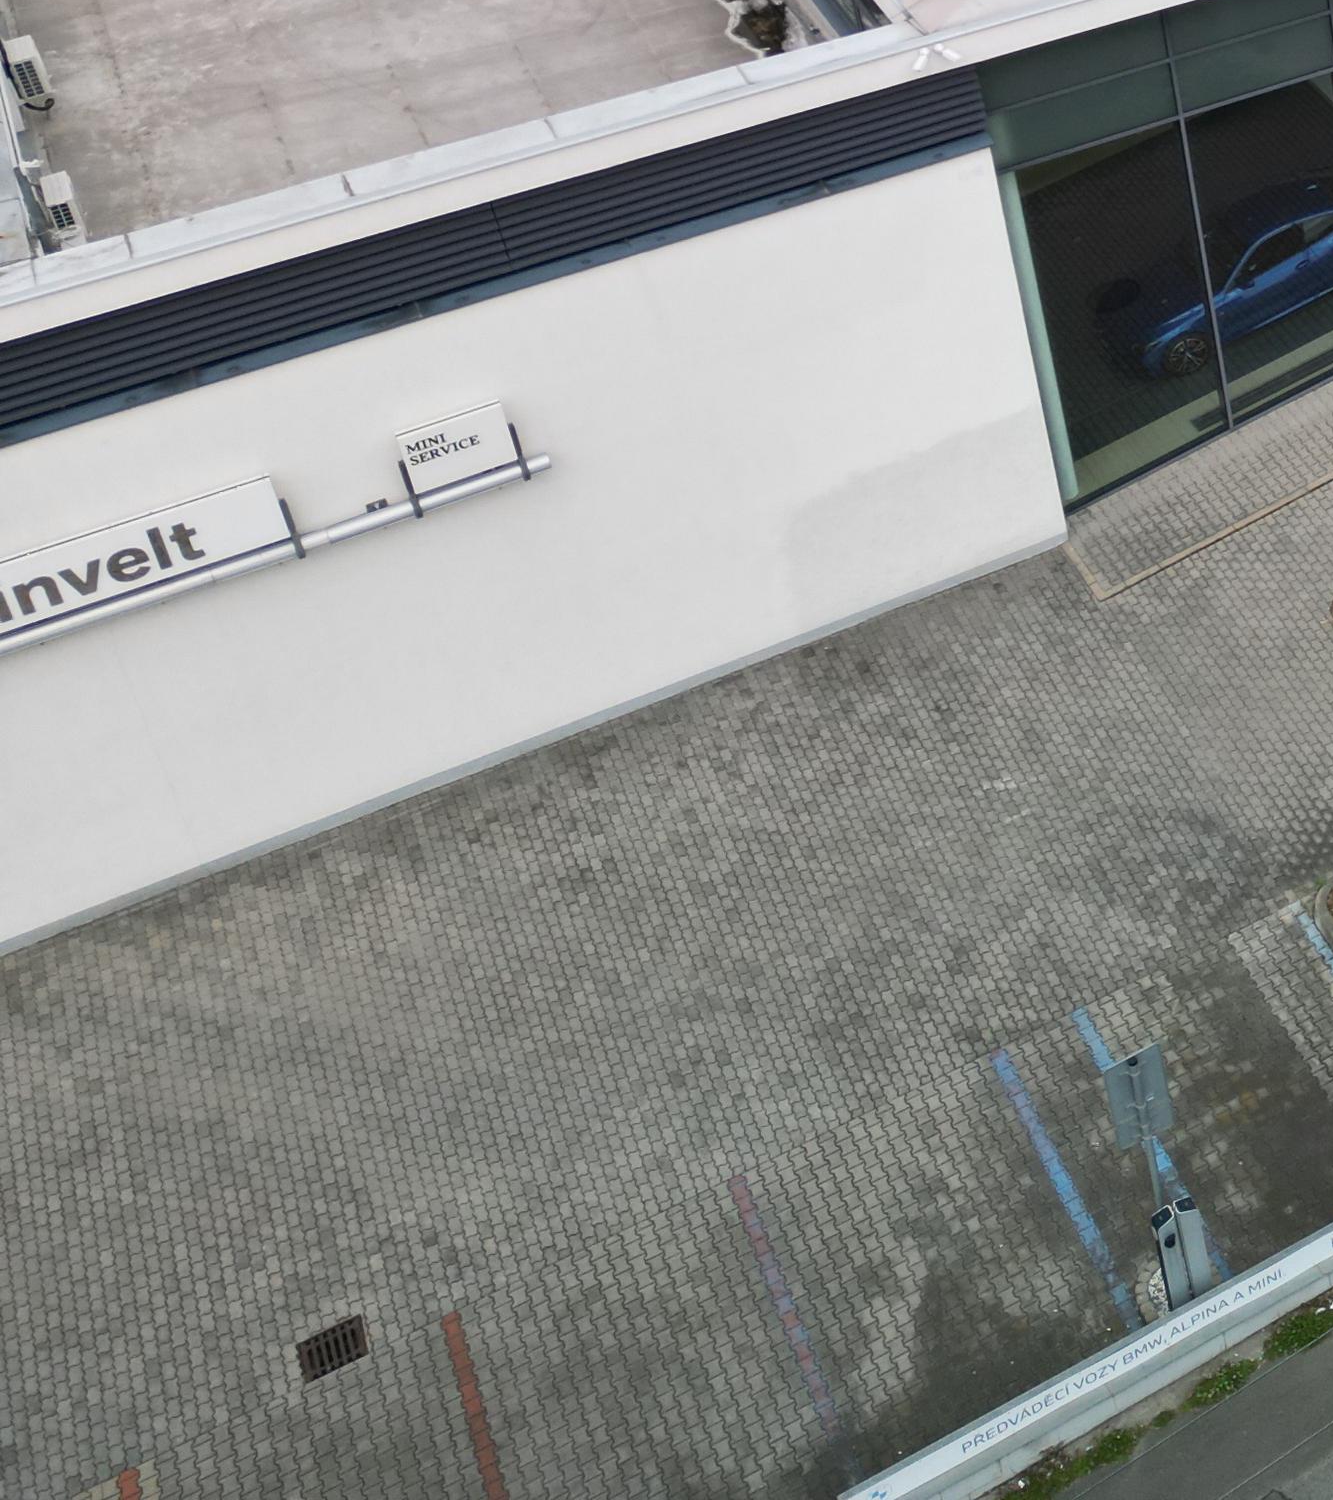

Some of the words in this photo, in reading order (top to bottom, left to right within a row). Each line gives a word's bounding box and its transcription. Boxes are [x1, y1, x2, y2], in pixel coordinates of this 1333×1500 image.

[405, 433, 447, 455] MINI
[409, 434, 480, 466] SERVICE
[1073, 1359, 1118, 1390] VOZY
[1122, 1334, 1168, 1365] BMW,
[1170, 1299, 1230, 1339] ALPINA
[1233, 1291, 1245, 1302] A
